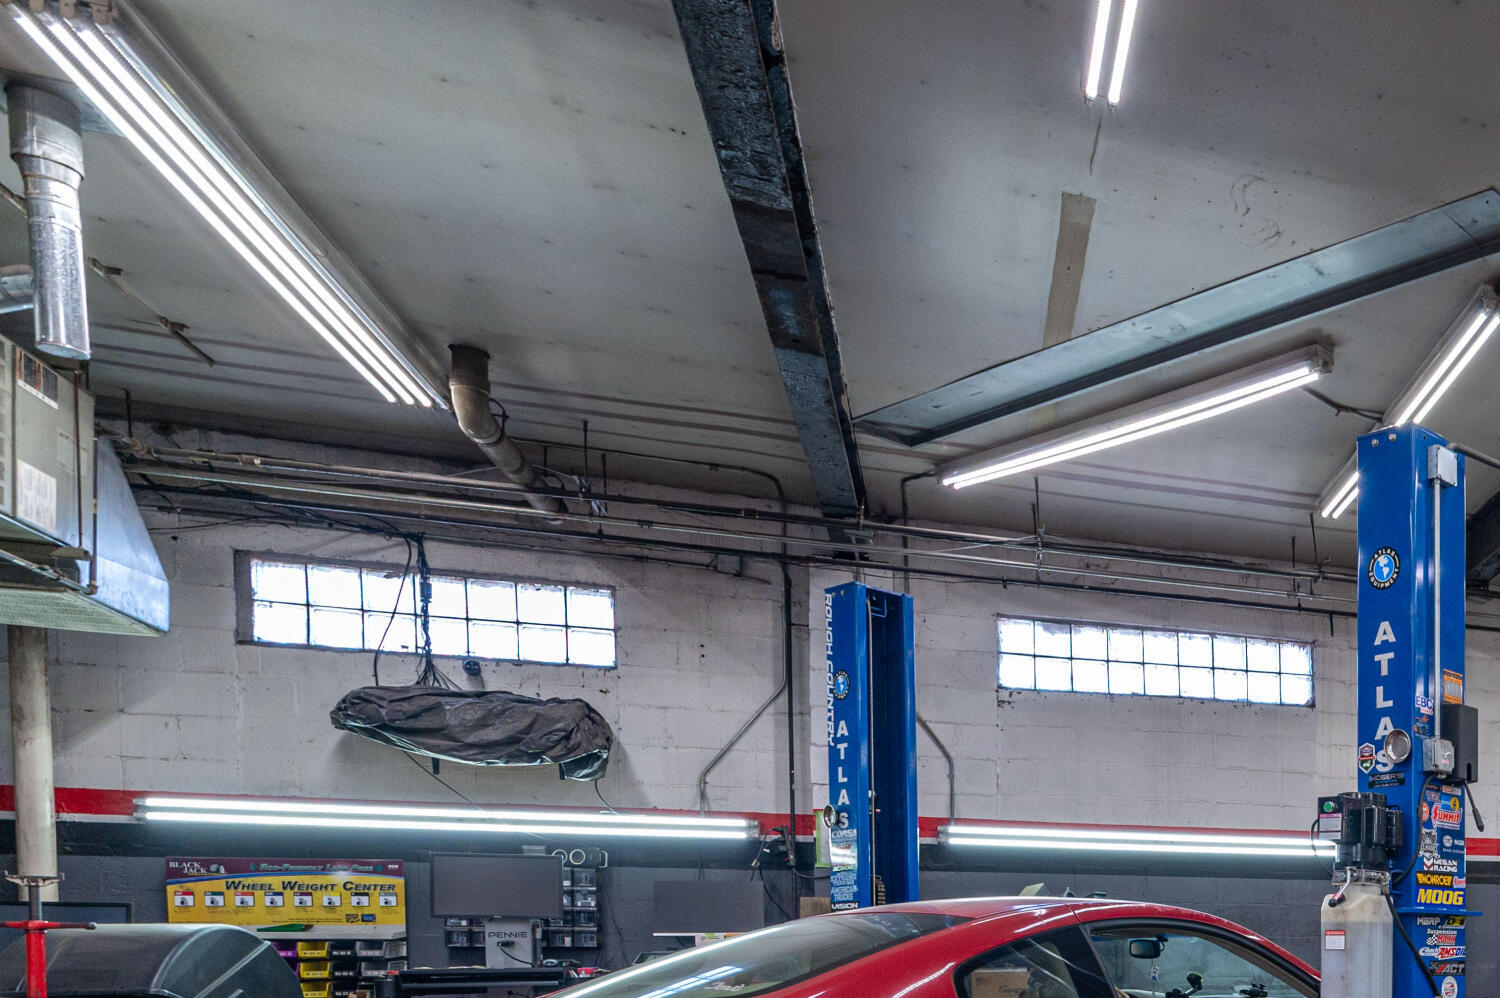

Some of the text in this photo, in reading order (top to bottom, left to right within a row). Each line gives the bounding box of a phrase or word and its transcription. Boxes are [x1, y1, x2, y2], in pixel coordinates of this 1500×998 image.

[1374, 548, 1395, 559] ATLAS
[1368, 568, 1400, 588] EQUIPMENT
[825, 593, 835, 747] ROUGH COUNTRY
[1374, 620, 1397, 773] ATLAS
[1415, 695, 1433, 710] EBC
[837, 720, 850, 829] ATLAS
[169, 861, 201, 869] BLACK
[183, 867, 208, 875] JACK
[1417, 873, 1453, 887] MONROE
[1417, 888, 1464, 905] MOOG
[831, 902, 859, 910] VISION
[1417, 917, 1440, 926] MBRP
[488, 931, 529, 939] PENNIE
[1426, 928, 1457, 936] Suspension
